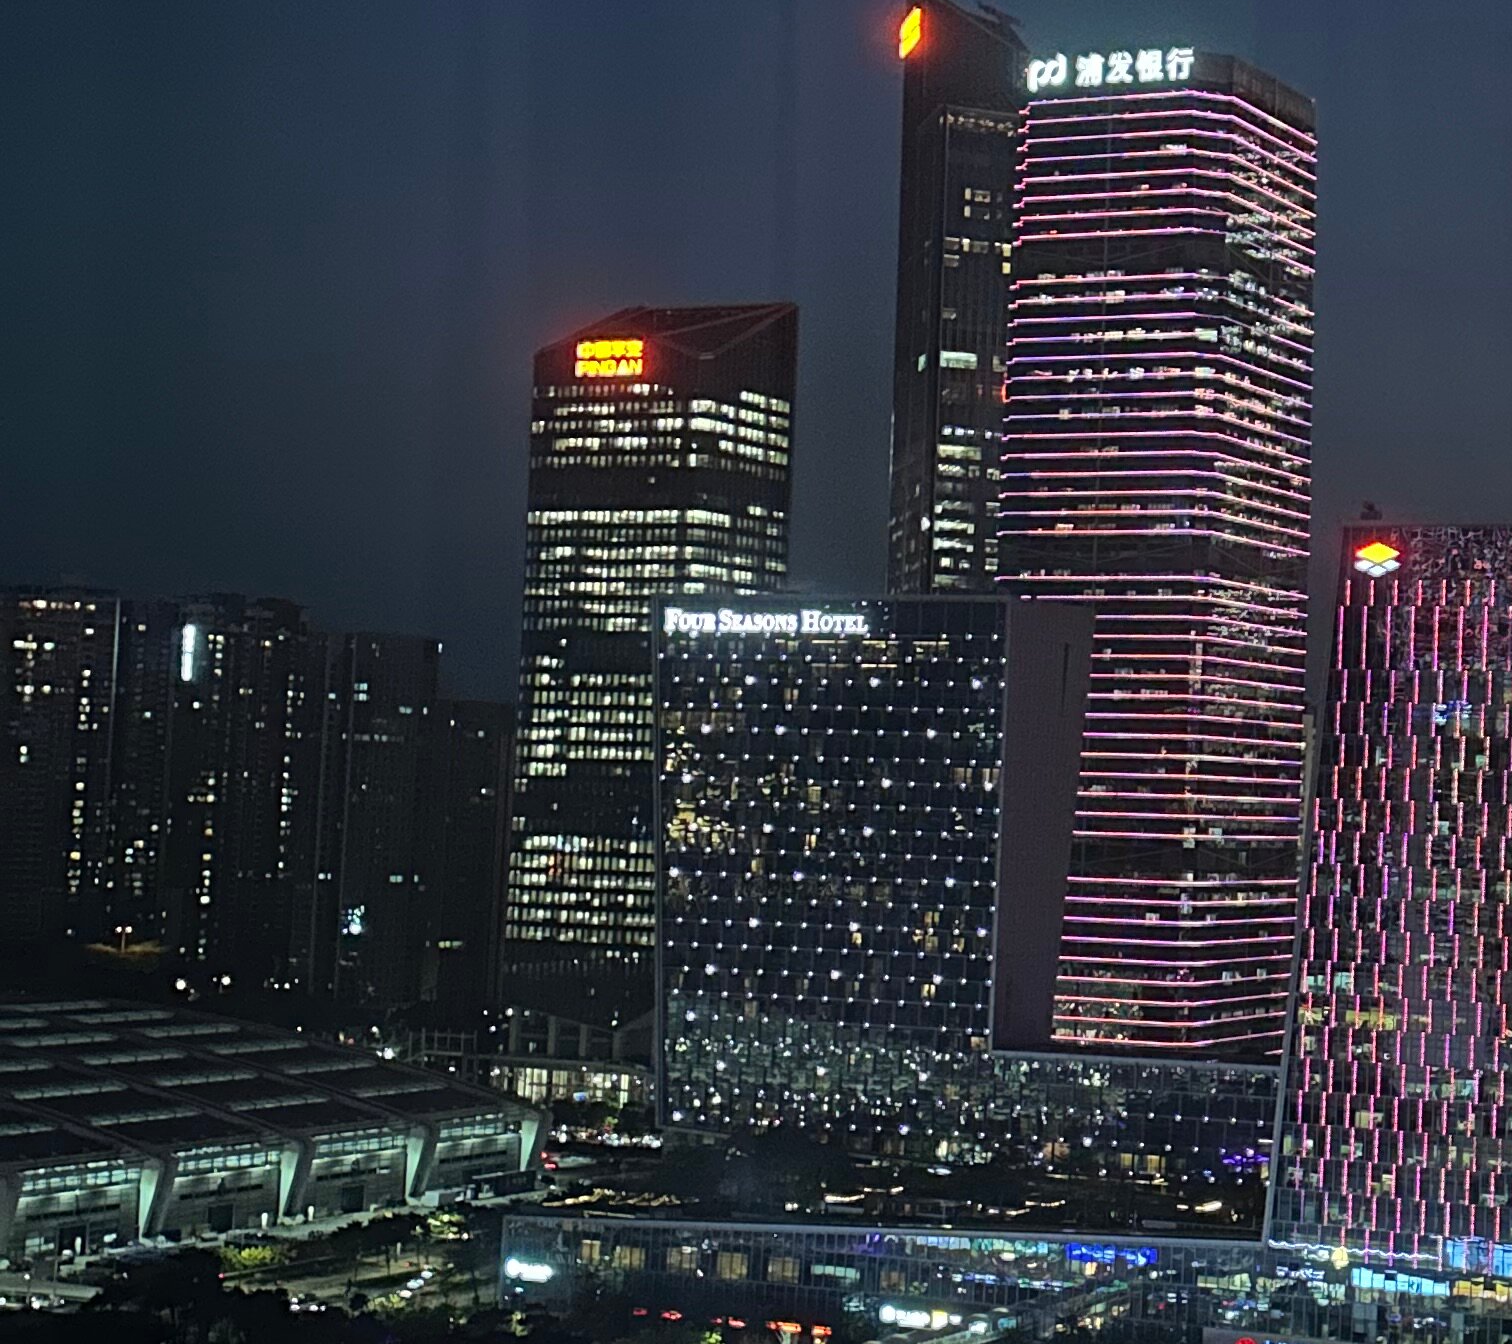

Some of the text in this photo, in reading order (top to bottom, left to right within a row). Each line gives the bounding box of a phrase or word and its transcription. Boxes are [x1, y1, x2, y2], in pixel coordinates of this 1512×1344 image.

[1075, 46, 1195, 87] 浦发银行
[664, 607, 868, 634] FOUR SEASONS HOTEL
